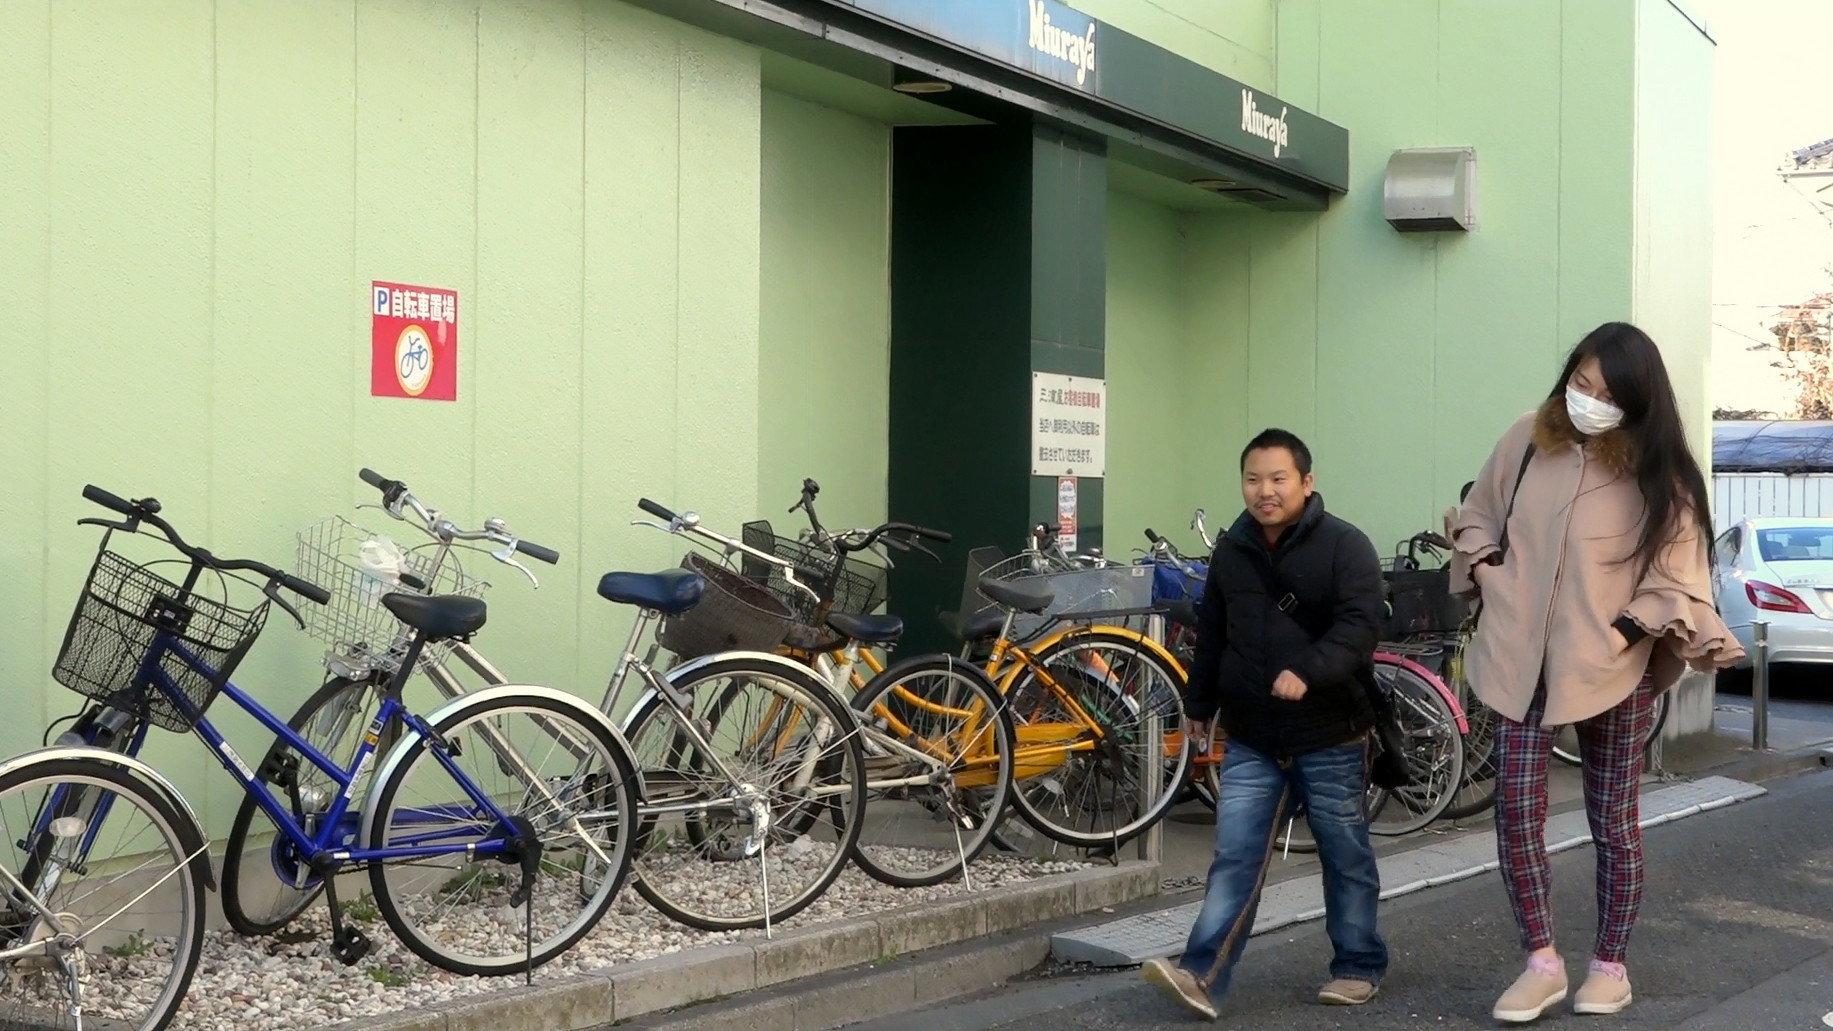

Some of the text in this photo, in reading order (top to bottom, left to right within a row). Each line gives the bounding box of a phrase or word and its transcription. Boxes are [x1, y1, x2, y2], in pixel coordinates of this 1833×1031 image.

[378, 288, 456, 324] P 自転車置場
